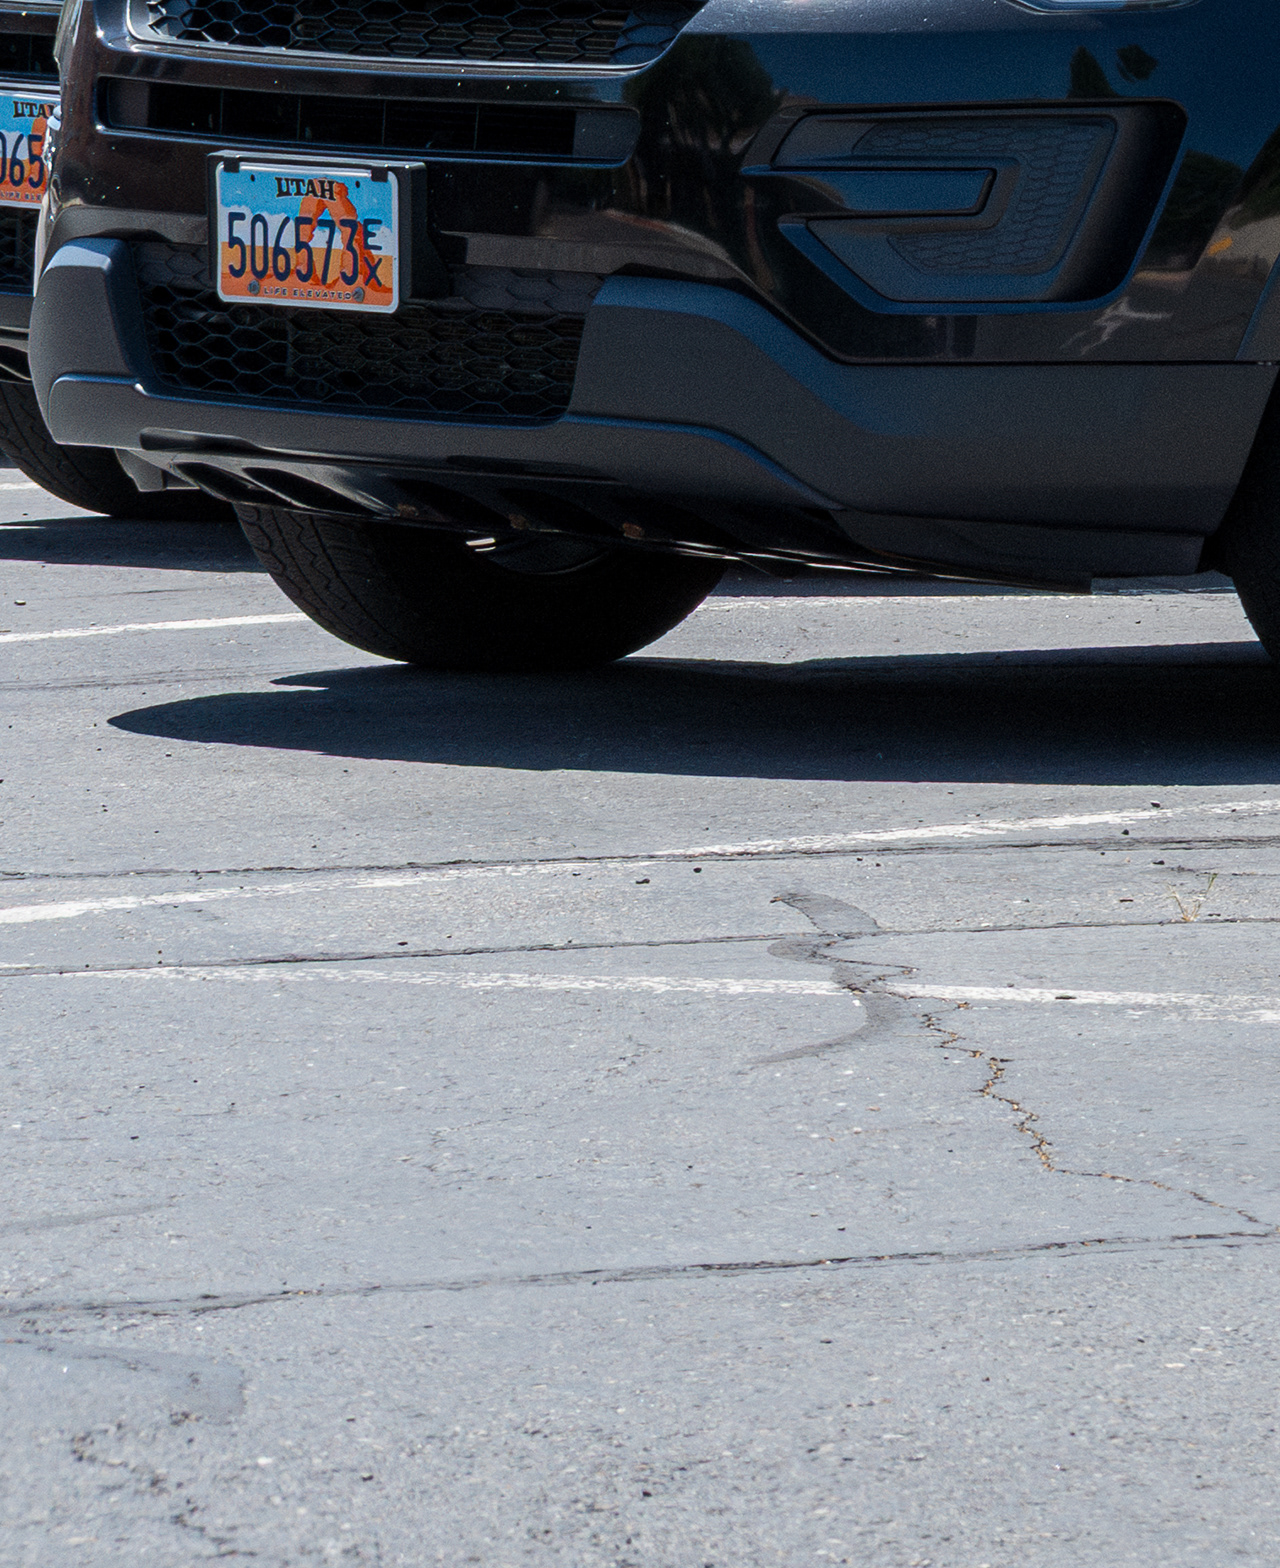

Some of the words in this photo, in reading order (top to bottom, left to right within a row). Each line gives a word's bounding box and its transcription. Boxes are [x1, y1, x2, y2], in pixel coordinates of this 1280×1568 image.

[274, 176, 337, 201] UTAH
[227, 211, 359, 286] 506573
[263, 286, 288, 296] LIFE
[292, 288, 352, 300] ELEVATED
